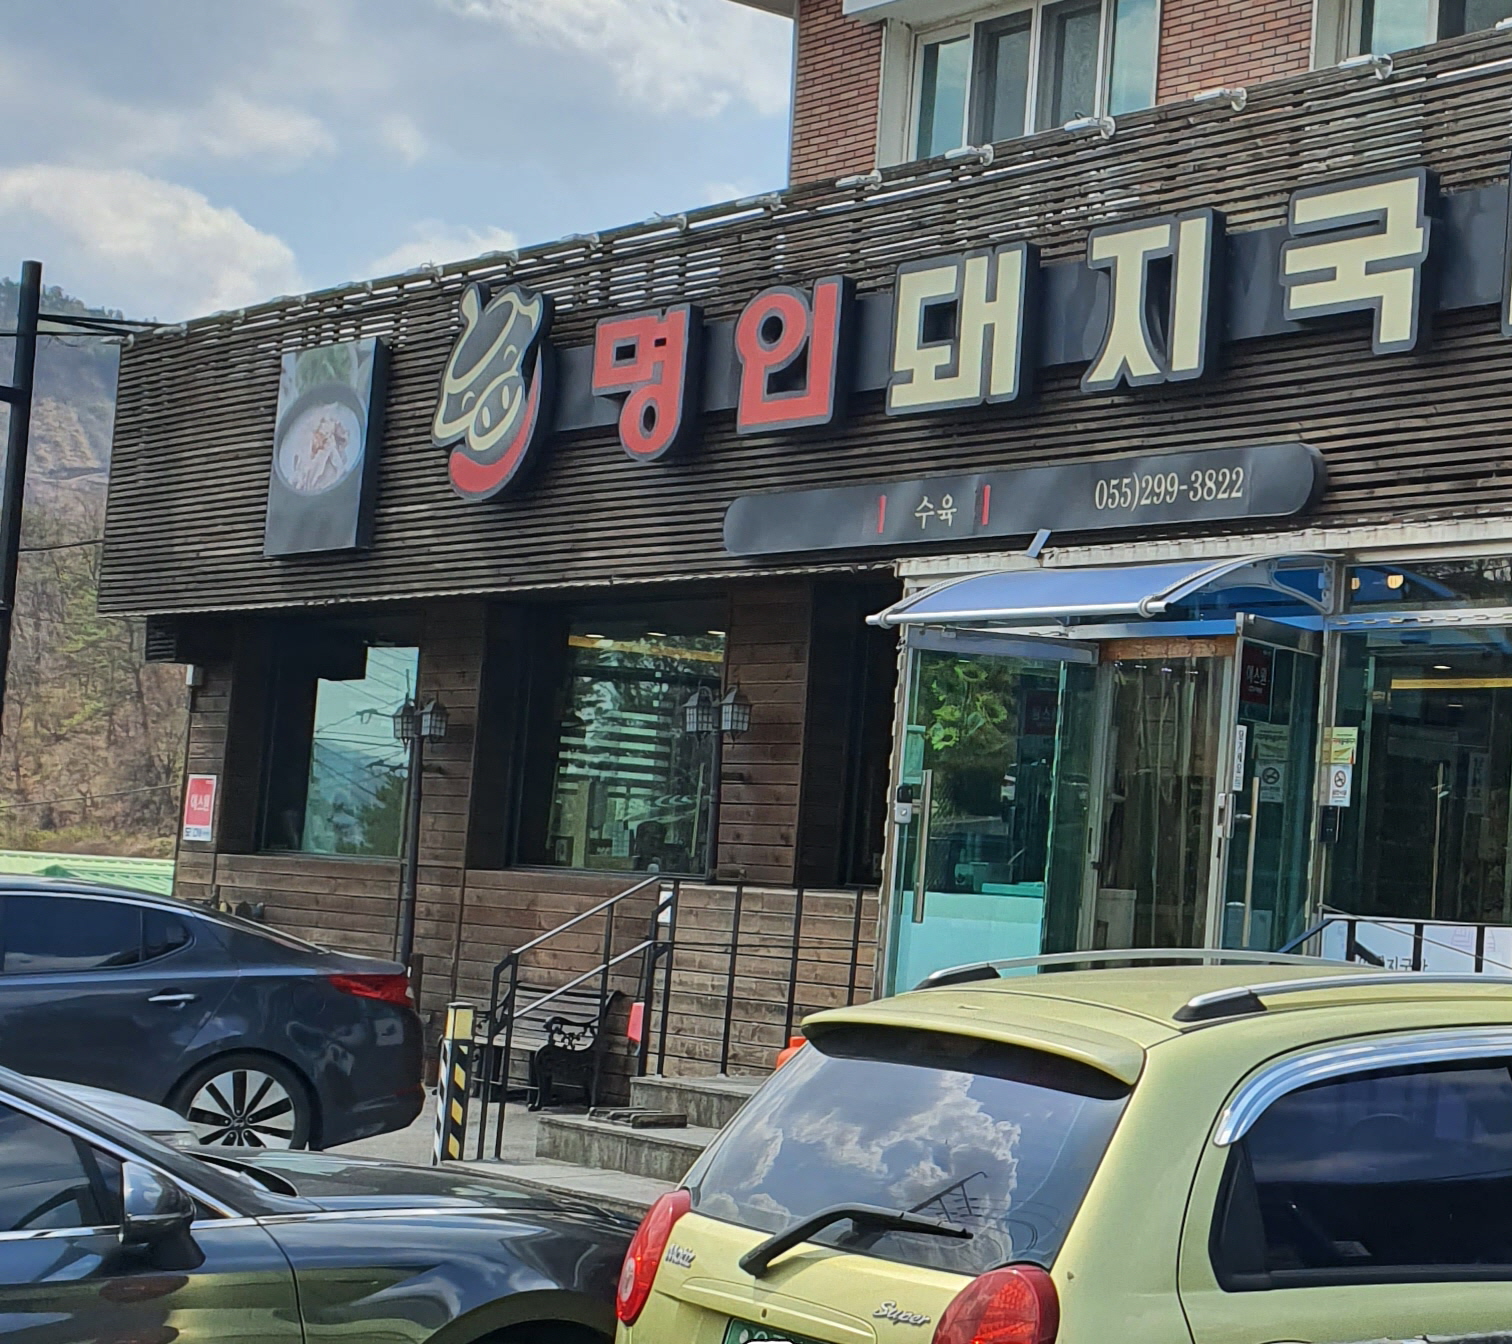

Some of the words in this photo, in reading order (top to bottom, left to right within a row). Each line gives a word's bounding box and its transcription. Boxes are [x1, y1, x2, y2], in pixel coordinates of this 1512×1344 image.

[1094, 467, 1245, 512] 055)299-3822
[914, 493, 958, 529] 수육
[872, 1299, 932, 1327] Super
